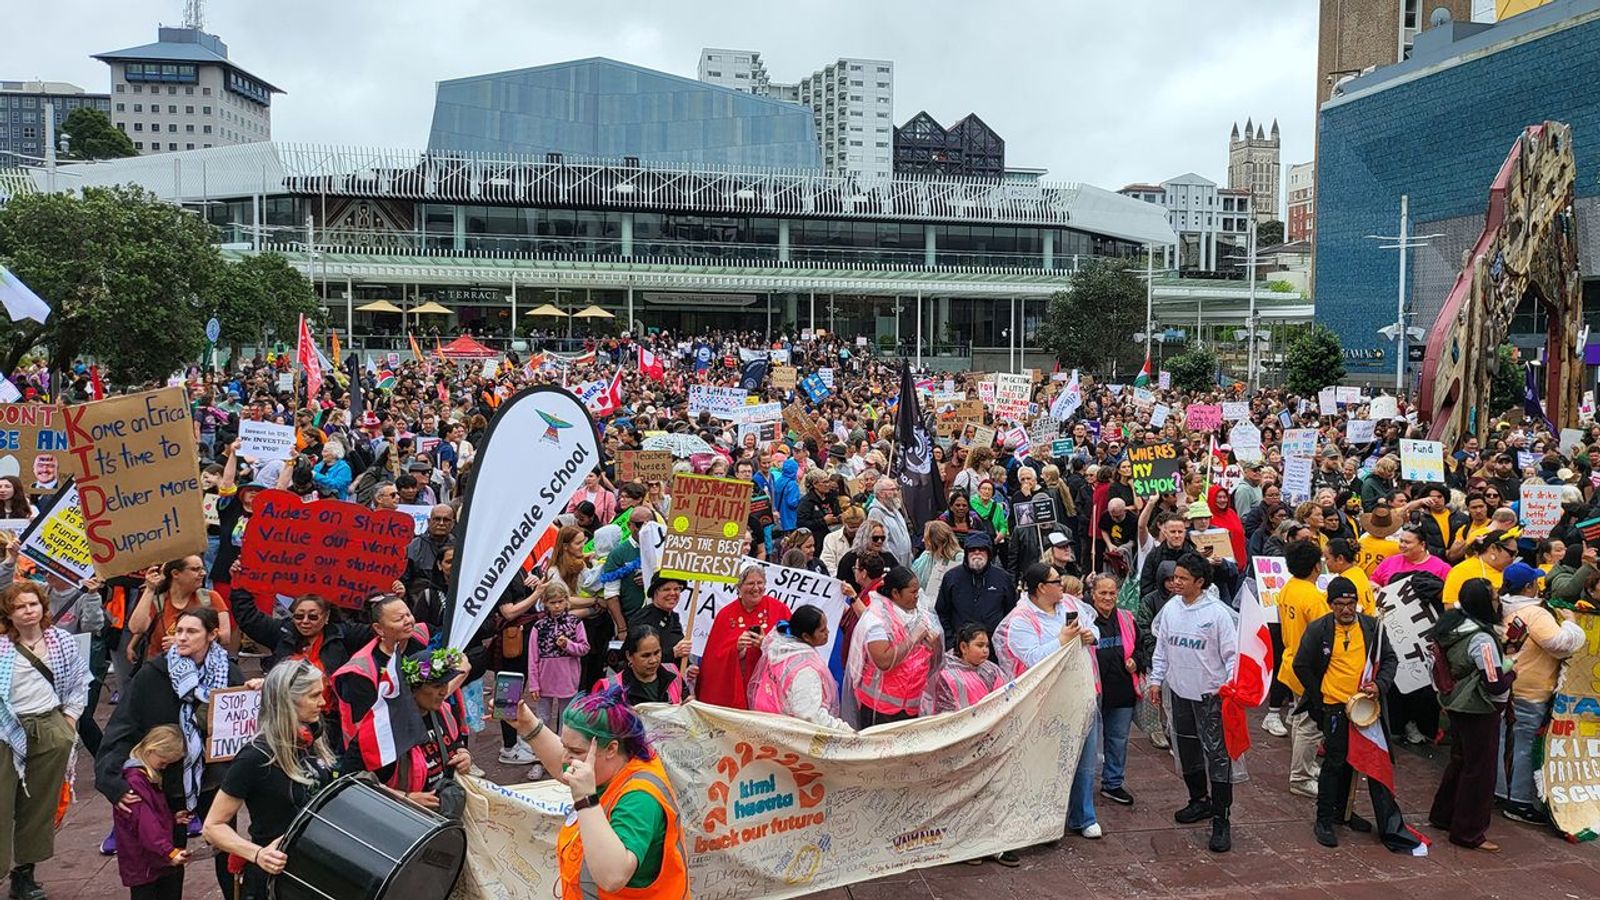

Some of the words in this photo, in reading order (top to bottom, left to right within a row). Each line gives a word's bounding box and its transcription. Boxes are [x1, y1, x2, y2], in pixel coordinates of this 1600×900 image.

[448, 290, 498, 300] TERRACE
[132, 418, 149, 432] on
[146, 389, 191, 427] Erica!
[122, 442, 156, 469] time
[159, 434, 181, 460] to
[634, 451, 672, 460] Teachers
[1412, 442, 1434, 454] Fund
[634, 461, 666, 470] Nurses
[1132, 462, 1152, 478] MY
[1134, 472, 1182, 494] $140K?
[65, 514, 76, 524] to
[260, 502, 311, 521] Aides
[318, 509, 342, 526] on
[674, 496, 690, 510] IN
[695, 496, 746, 522] HEALTH
[52, 522, 79, 542] Fund
[258, 526, 312, 546] Value
[322, 534, 348, 548] our
[463, 504, 544, 618] Rowandale
[540, 442, 590, 504] School
[34, 536, 60, 556] they
[48, 532, 90, 560] support
[665, 534, 694, 550] PAYS
[698, 538, 714, 552] THE
[718, 538, 744, 556] BEST
[314, 556, 338, 568] our
[662, 550, 741, 578] INTEREST
[272, 572, 298, 586] pay
[304, 570, 316, 582] is
[320, 574, 332, 586] a
[774, 568, 832, 599] SPELL
[340, 592, 366, 606] rig
[220, 694, 248, 710] STOP
[224, 710, 248, 722] AND
[232, 719, 256, 736] FUN
[1551, 720, 1576, 736] UP
[694, 828, 740, 855] back
[741, 823, 768, 842] our
[770, 811, 824, 834] future
